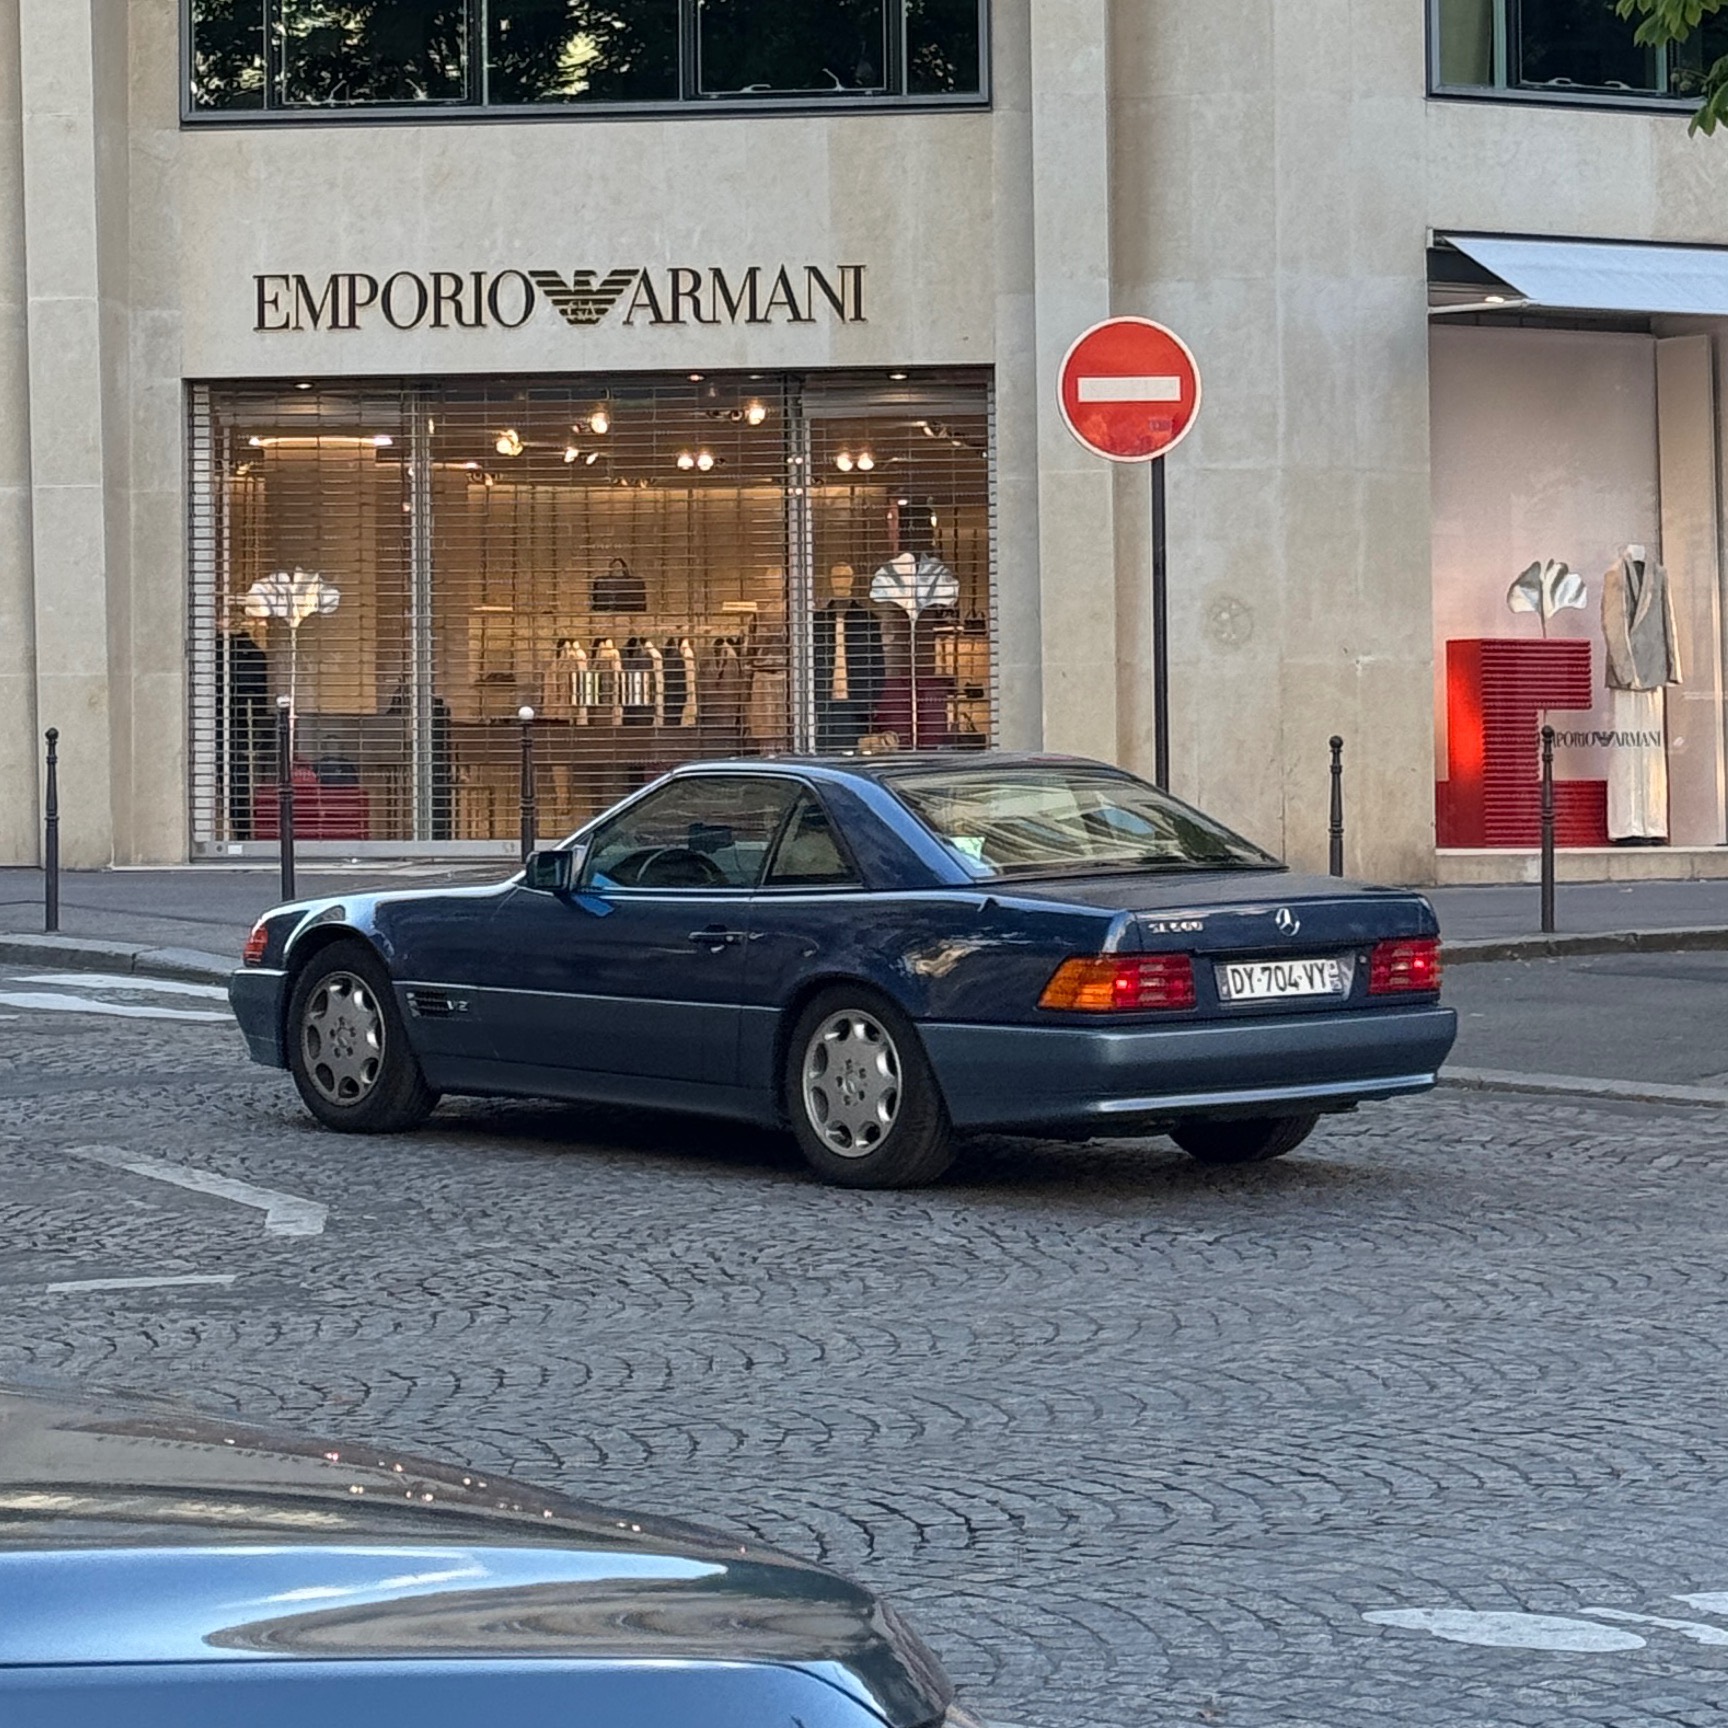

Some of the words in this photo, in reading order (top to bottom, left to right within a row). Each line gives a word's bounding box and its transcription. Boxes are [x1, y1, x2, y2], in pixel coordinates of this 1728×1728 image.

[252, 269, 535, 331] EMPORIO
[622, 264, 867, 325] ARMANI
[1551, 731, 1595, 748] PORIO
[1613, 730, 1661, 748] ARMANI
